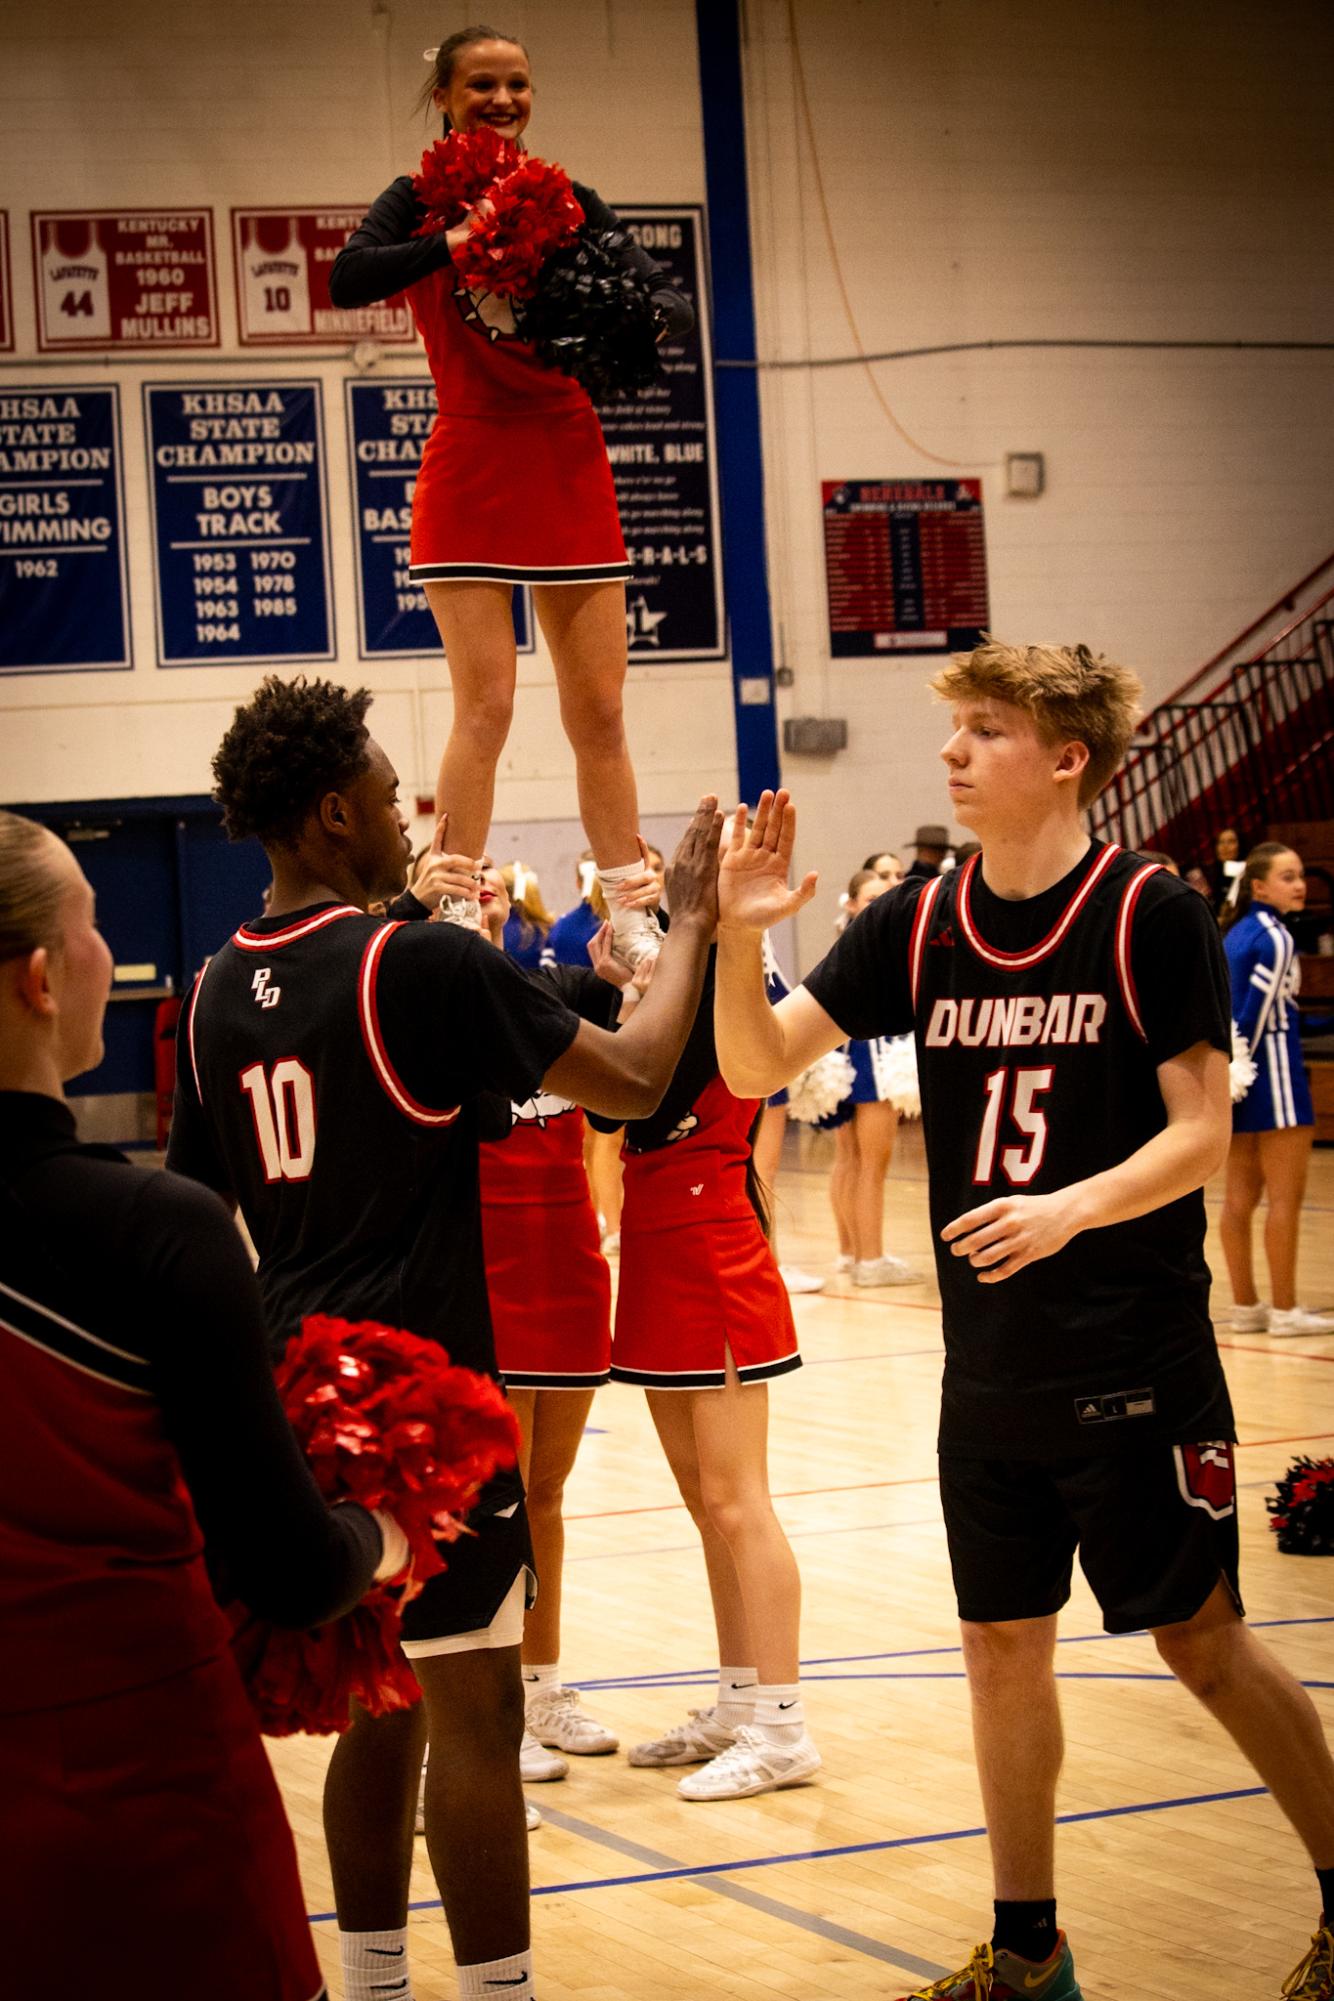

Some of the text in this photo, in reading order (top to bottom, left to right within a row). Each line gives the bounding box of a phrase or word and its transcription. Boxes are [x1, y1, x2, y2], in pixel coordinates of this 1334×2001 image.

[117, 218, 200, 233] KENTUCKY
[145, 235, 174, 248] MR.
[115, 250, 205, 265] BASKETBALL
[135, 268, 185, 287] 1960
[60, 290, 94, 316] 44
[134, 292, 194, 314] JEFF
[264, 287, 290, 312] 10
[120, 315, 209, 339] MULLINS
[0, 398, 81, 419] HSAA
[182, 393, 285, 415] KHSAA
[383, 388, 438, 411] KHS
[0, 424, 76, 445] TATE
[190, 418, 281, 440] STATE
[0, 448, 111, 472] AMPION
[157, 442, 315, 467] CHAMPION
[606, 442, 704, 464] WHITE, BLUE
[0, 492, 70, 516] GIRLS
[203, 486, 273, 509] BOYS
[0, 518, 112, 543] IMMING
[197, 512, 282, 536] TRACK
[193, 552, 296, 572] 1953 1970
[626, 545, 707, 566] E-R-A-L-S
[15, 559, 58, 578] 1962
[194, 575, 295, 595] 1954 1978
[196, 598, 297, 619] 1963 1985
[196, 624, 240, 642] 1964
[924, 993, 1108, 1048] DUNBAR
[239, 1055, 316, 1184] 10
[972, 1065, 1056, 1186] 15
